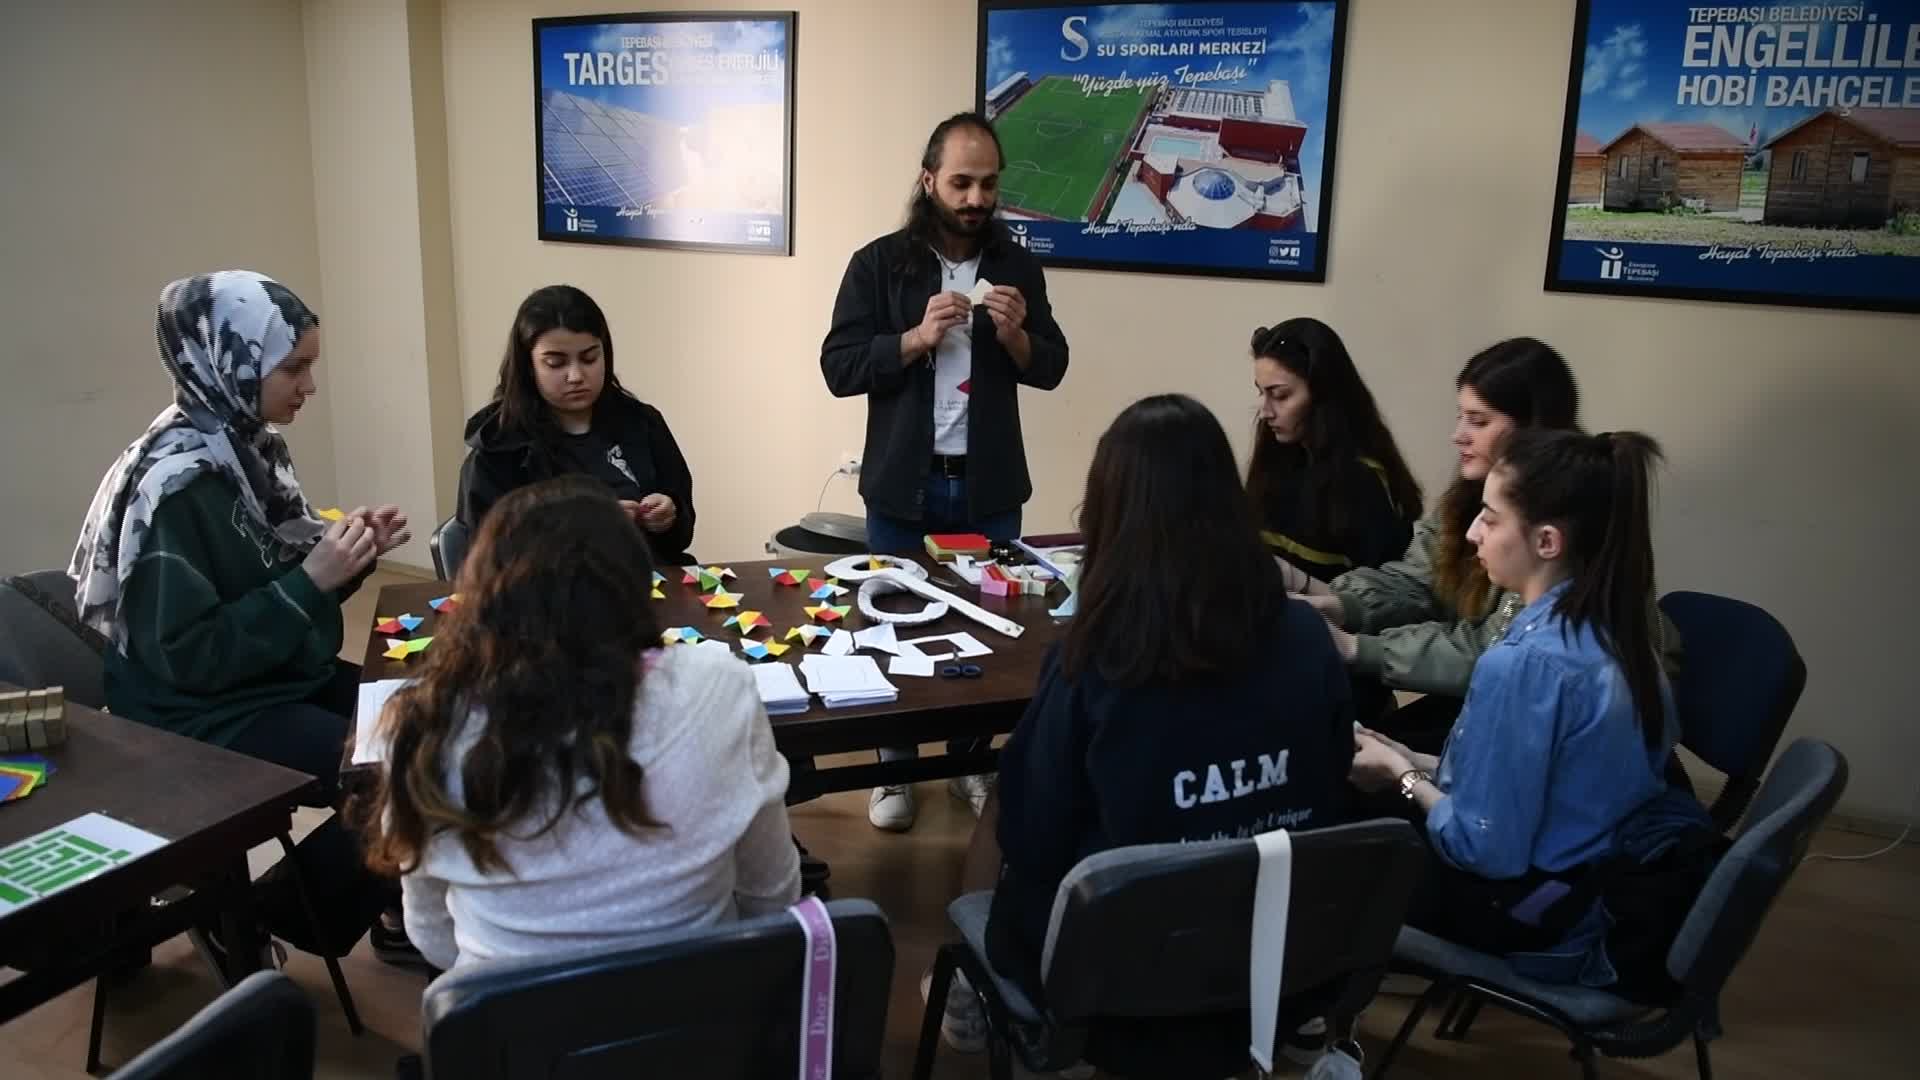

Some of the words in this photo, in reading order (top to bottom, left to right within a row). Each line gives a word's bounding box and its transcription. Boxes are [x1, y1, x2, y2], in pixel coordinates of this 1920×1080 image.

[1688, 7, 1765, 26] TEPEBAŞI
[1769, 2, 1865, 23] BELEDİYESİ
[1060, 15, 1090, 62] S
[1096, 43, 1116, 57] SU
[1119, 41, 1195, 57] SPORLARI
[1199, 37, 1267, 56] MERKEZİ
[563, 52, 669, 86] TARGES
[1136, 71, 1170, 95] yüz
[1677, 69, 1758, 106] HOBİ
[1081, 220, 1121, 239] Hayal
[1122, 216, 1198, 237] Tepebaşı'nda
[1698, 244, 1751, 265] Hayal
[1756, 240, 1858, 264] Tepebaşı'nda
[1173, 749, 1290, 809] CALM
